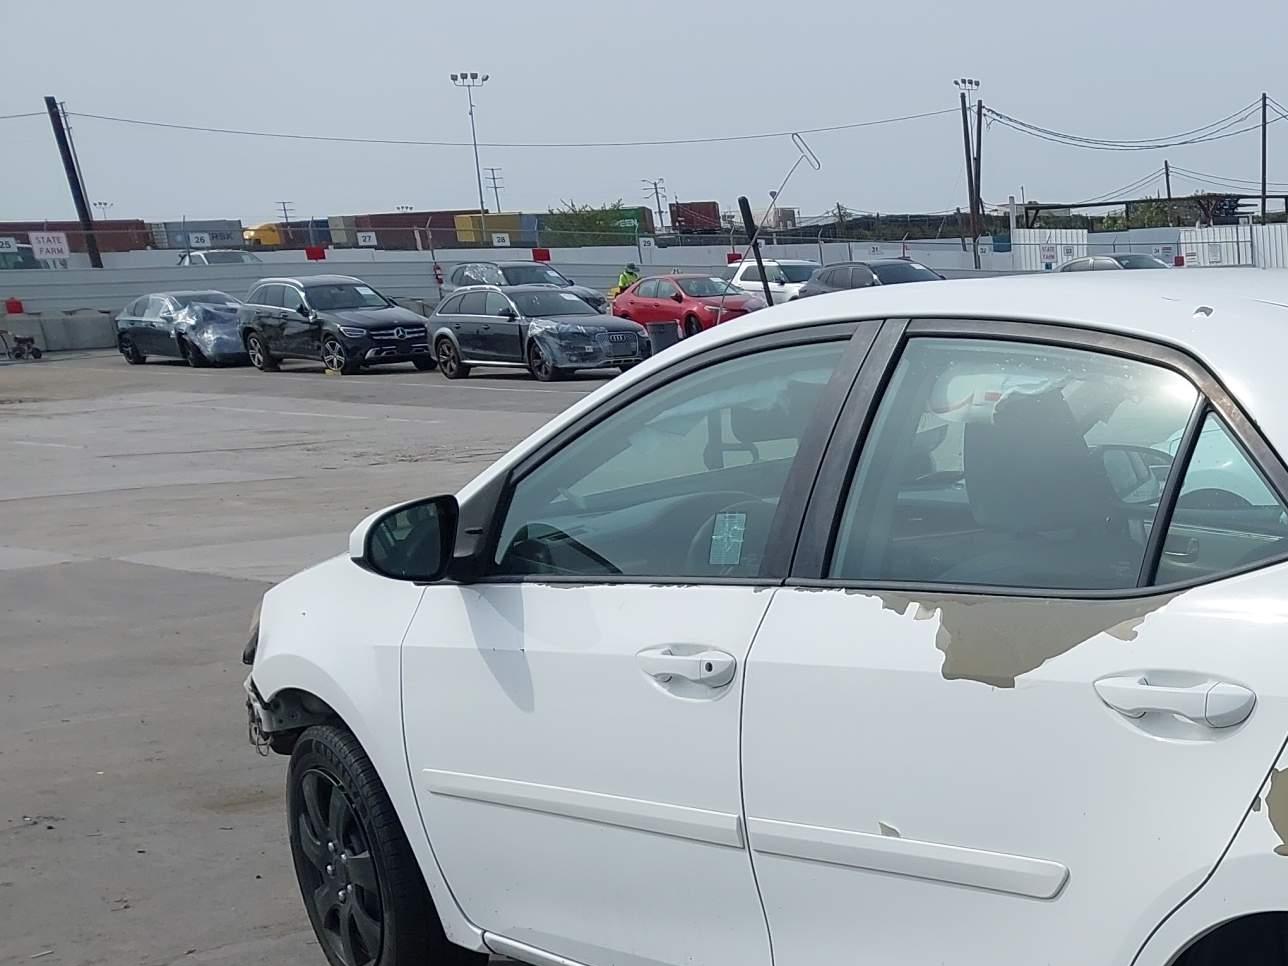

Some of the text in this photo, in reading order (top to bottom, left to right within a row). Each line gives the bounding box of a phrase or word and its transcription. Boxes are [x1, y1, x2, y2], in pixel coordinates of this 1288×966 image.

[35, 236, 62, 244] STATE
[194, 236, 206, 244] 26
[361, 235, 372, 243] 27
[0, 240, 12, 249] 25
[39, 247, 65, 255] FARM
